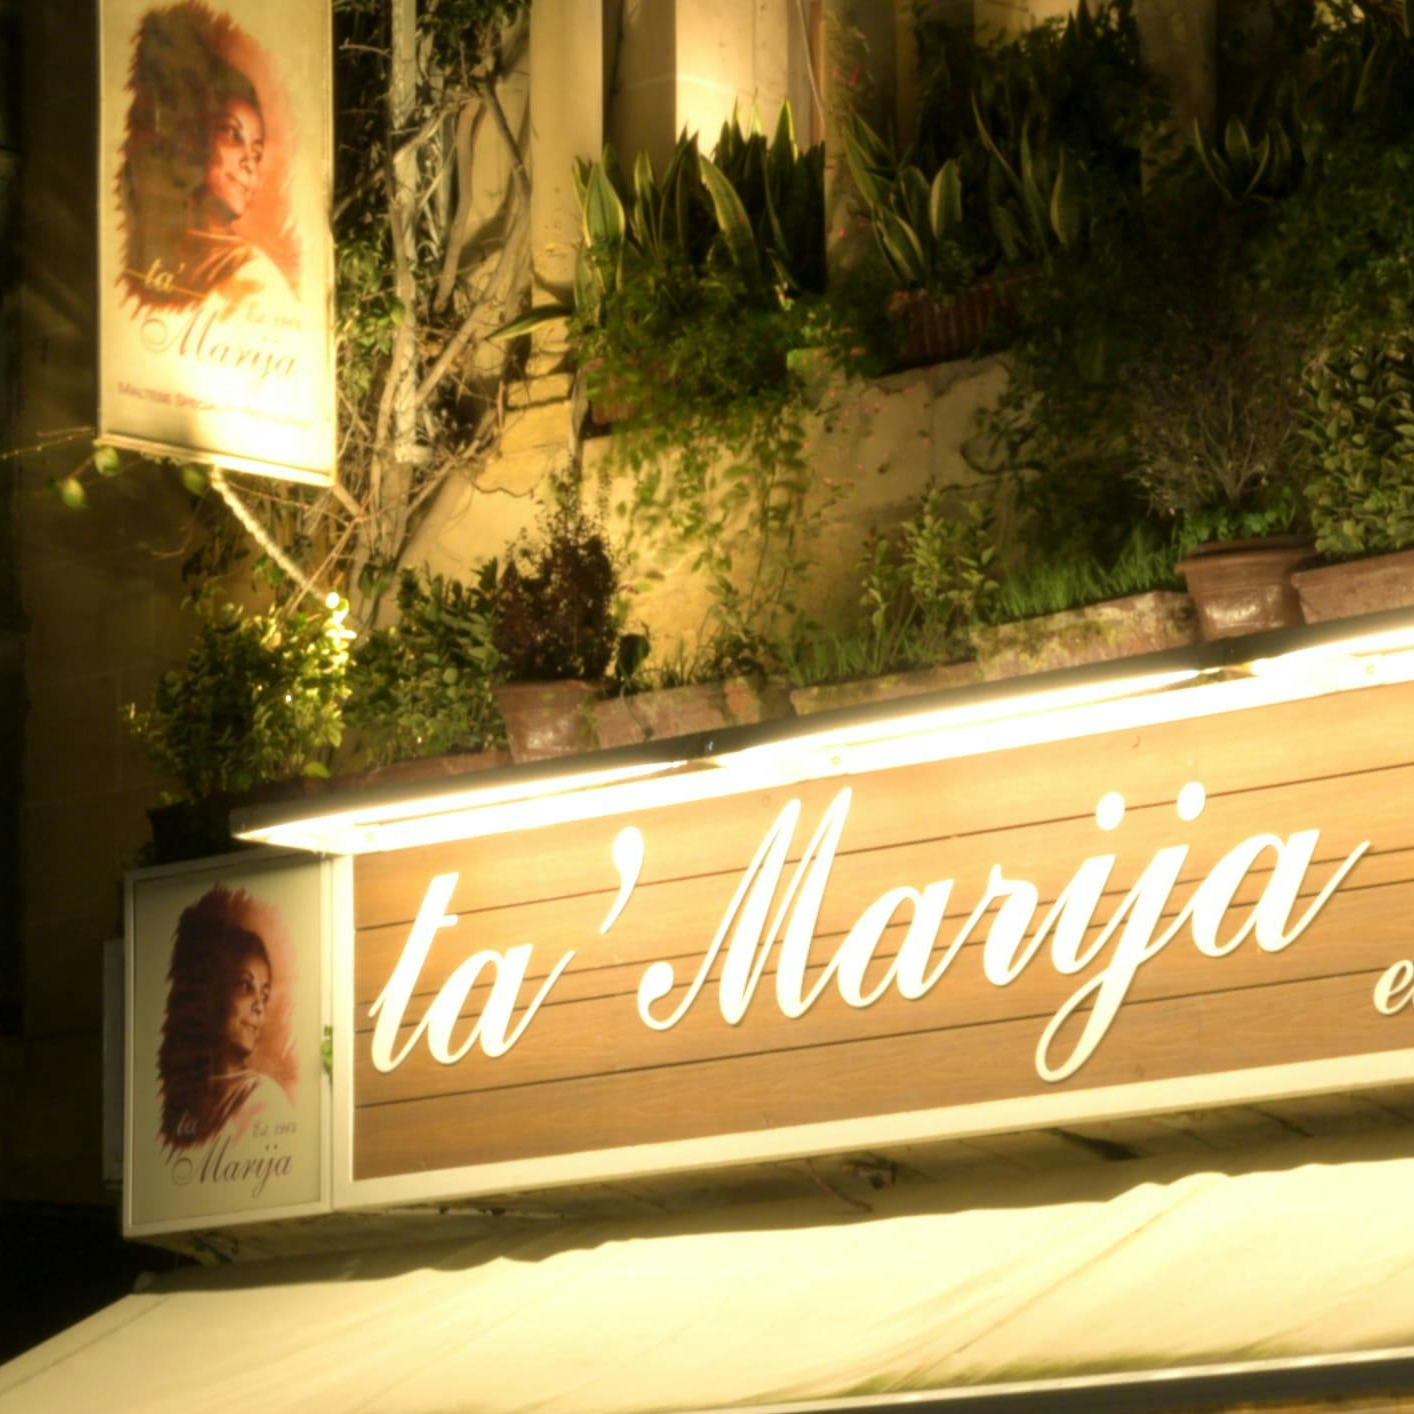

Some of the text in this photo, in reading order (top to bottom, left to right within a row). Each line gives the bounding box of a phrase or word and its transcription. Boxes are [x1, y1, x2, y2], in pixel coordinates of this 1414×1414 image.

[368, 825, 645, 1074] ta'
[636, 784, 1372, 1083] Marija
[170, 1134, 293, 1200] Marija
